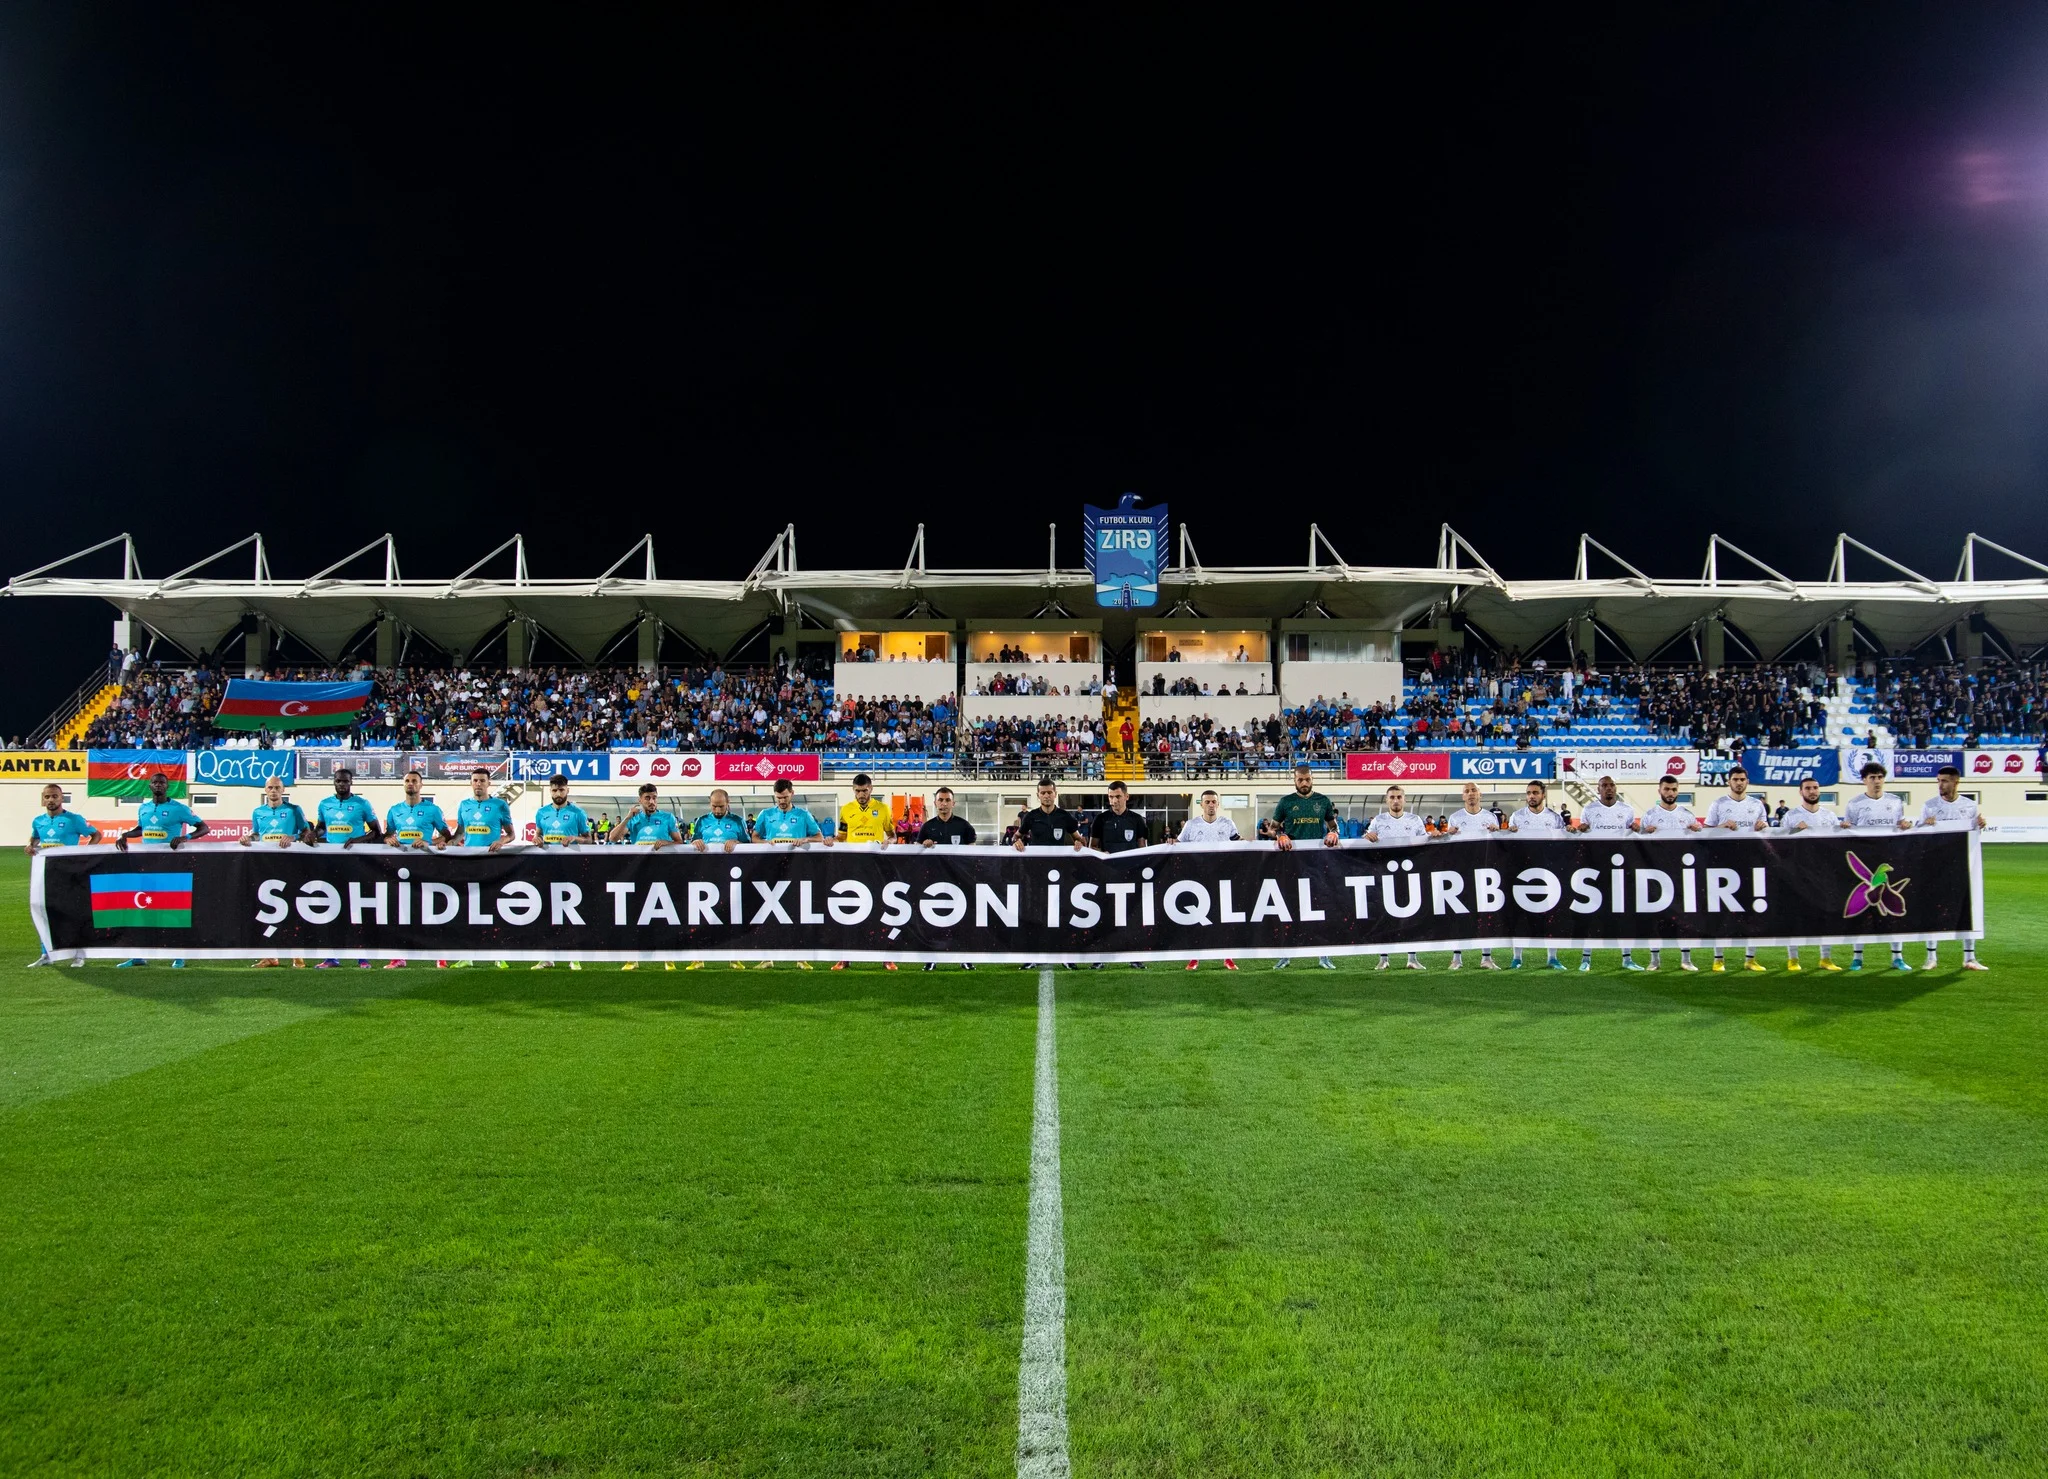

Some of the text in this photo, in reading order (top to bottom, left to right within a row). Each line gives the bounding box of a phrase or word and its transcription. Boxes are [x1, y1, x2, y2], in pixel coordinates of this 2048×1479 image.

[1100, 516, 1152, 524] FUTBOL KLUBU
[0, 758, 82, 772] ANTRAL
[1894, 754, 1953, 764] TO RACISM
[1974, 760, 1993, 768] nar
[2005, 760, 2024, 768] nar
[197, 750, 291, 782] Qartal
[518, 758, 599, 776] K@TV 1
[621, 763, 639, 772] nar
[652, 763, 670, 772] nar
[683, 763, 701, 772] nar
[728, 761, 805, 775] azfar group
[1361, 761, 1437, 773] azfar group
[1462, 758, 1542, 775] K@TV 1
[1580, 759, 1648, 772] Kapital Bank
[1667, 762, 1686, 770] nar
[1764, 766, 1814, 784] Tayfa
[255, 853, 1768, 940] ŞƏHİDLƏR TARİXLƏŞƏN İSTİQLAL TÜRBƏSİDİR!
